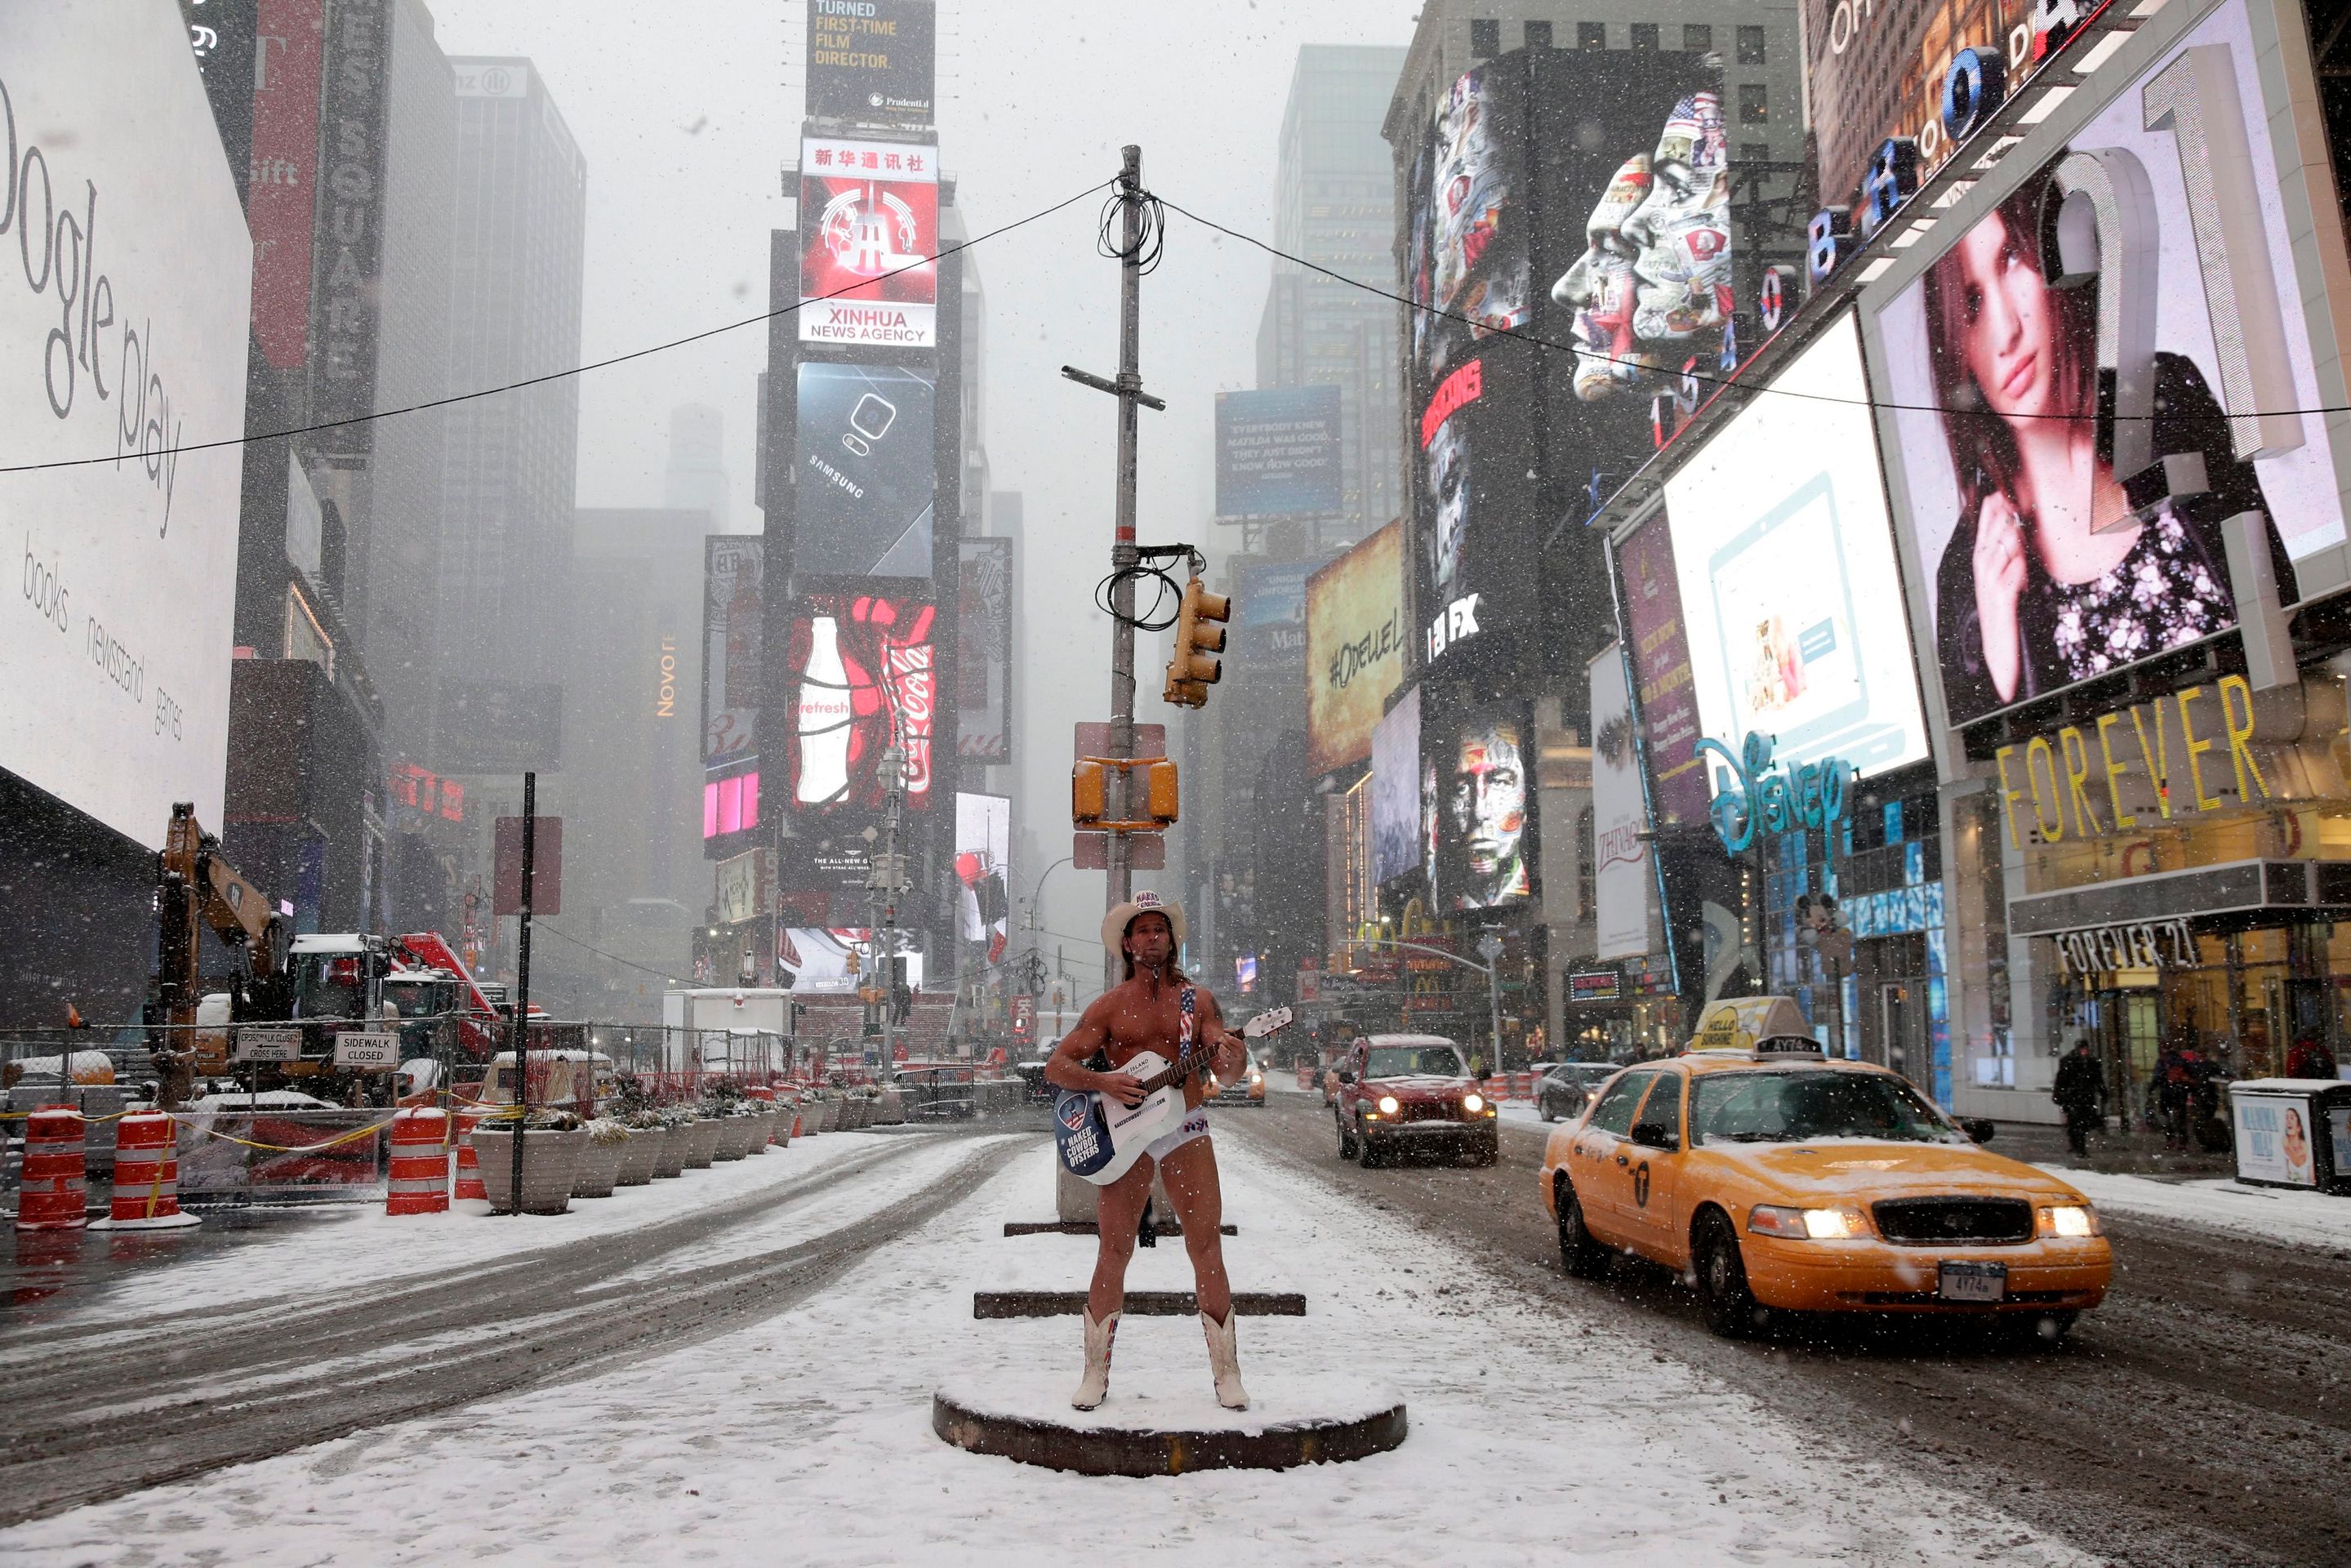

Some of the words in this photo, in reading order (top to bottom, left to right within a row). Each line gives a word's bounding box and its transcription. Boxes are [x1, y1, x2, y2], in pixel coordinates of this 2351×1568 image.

[817, 0, 875, 16] TURNED
[816, 16, 897, 35] FIRST-TIME
[816, 33, 850, 49] FILM
[815, 50, 892, 69] DIRECTOR.
[815, 149, 924, 172] 新华通讯社
[829, 309, 907, 327] XINHUA
[811, 325, 856, 339] NEWS
[861, 327, 925, 341] AGENCY
[1294, 420, 1326, 430] KNEW
[1227, 435, 1271, 447] MATILDA
[1273, 434, 1296, 443] WAS
[1232, 449, 1259, 459] THEY
[1262, 447, 1286, 457] JUST
[1231, 461, 1264, 471] KNOW
[1267, 459, 1292, 470] HOW
[809, 455, 864, 498] SAMSUNG
[23, 531, 69, 633] books
[1449, 592, 1480, 643] FX
[87, 613, 145, 704] newsstand
[155, 686, 183, 742] games
[800, 701, 849, 715] refresh
[1995, 673, 2272, 851] FOREVER
[2055, 924, 2164, 974] FOREVER
[241, 1032, 275, 1043] CROSSWALK
[276, 1033, 297, 1043] CLOSED
[344, 1038, 390, 1049] SIDEWALK
[250, 1049, 271, 1058] CROSS
[271, 1049, 287, 1058] HERE
[348, 1051, 384, 1060] CLOSED
[1130, 1058, 1150, 1072] ISLAND
[1067, 1125, 1092, 1147] NAKED
[1066, 1134, 1098, 1159] COWBOY
[1069, 1143, 1100, 1168] OYSTERS
